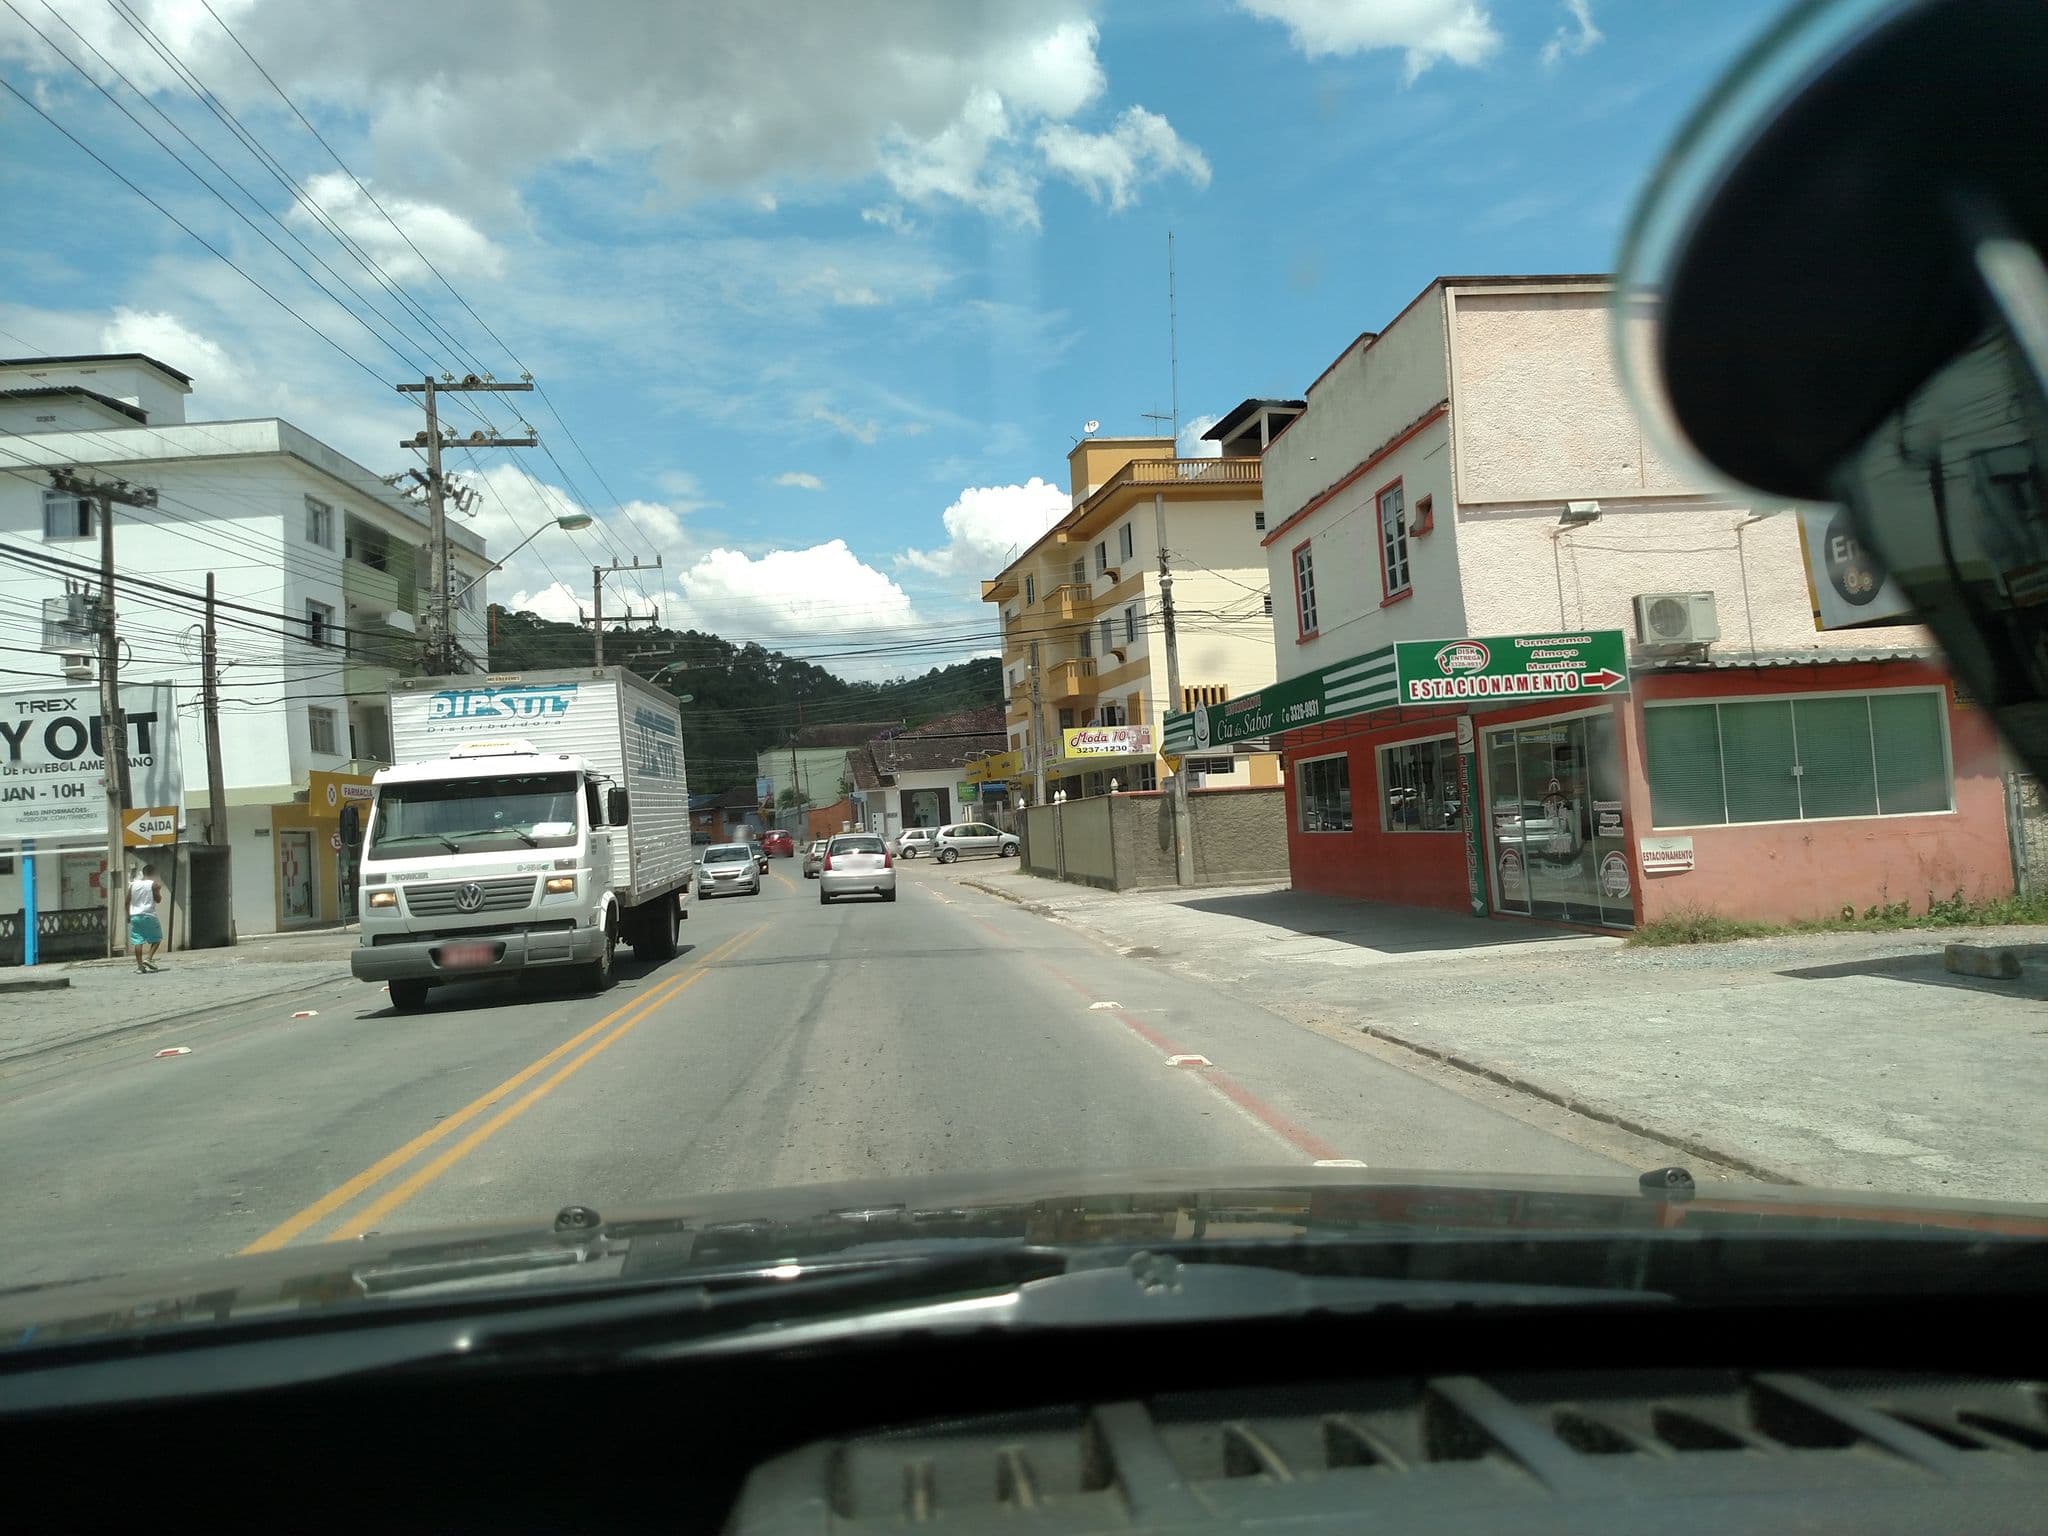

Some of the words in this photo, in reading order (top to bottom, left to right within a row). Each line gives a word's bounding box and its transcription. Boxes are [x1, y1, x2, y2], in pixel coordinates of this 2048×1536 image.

[1515, 636, 1591, 647] Fornecemos
[1531, 649, 1578, 659] Almoço
[1527, 660, 1586, 671] Marmitex
[1410, 673, 1577, 698] ESTACIONAMENTO
[429, 693, 571, 720] DIPSUL
[427, 720, 561, 733] Distribuidora
[1217, 719, 1233, 741] Cia
[1243, 708, 1274, 735] Sabor
[1070, 729, 1107, 747] Moda
[1114, 730, 1127, 741] 10
[1076, 745, 1128, 753] 3237-1230
[3, 764, 18, 776] DE
[79, 756, 153, 772] AMEANO
[2, 785, 35, 802] JAN
[52, 783, 85, 798] 10H
[1643, 850, 1693, 861] ESTACIONAMENTO
